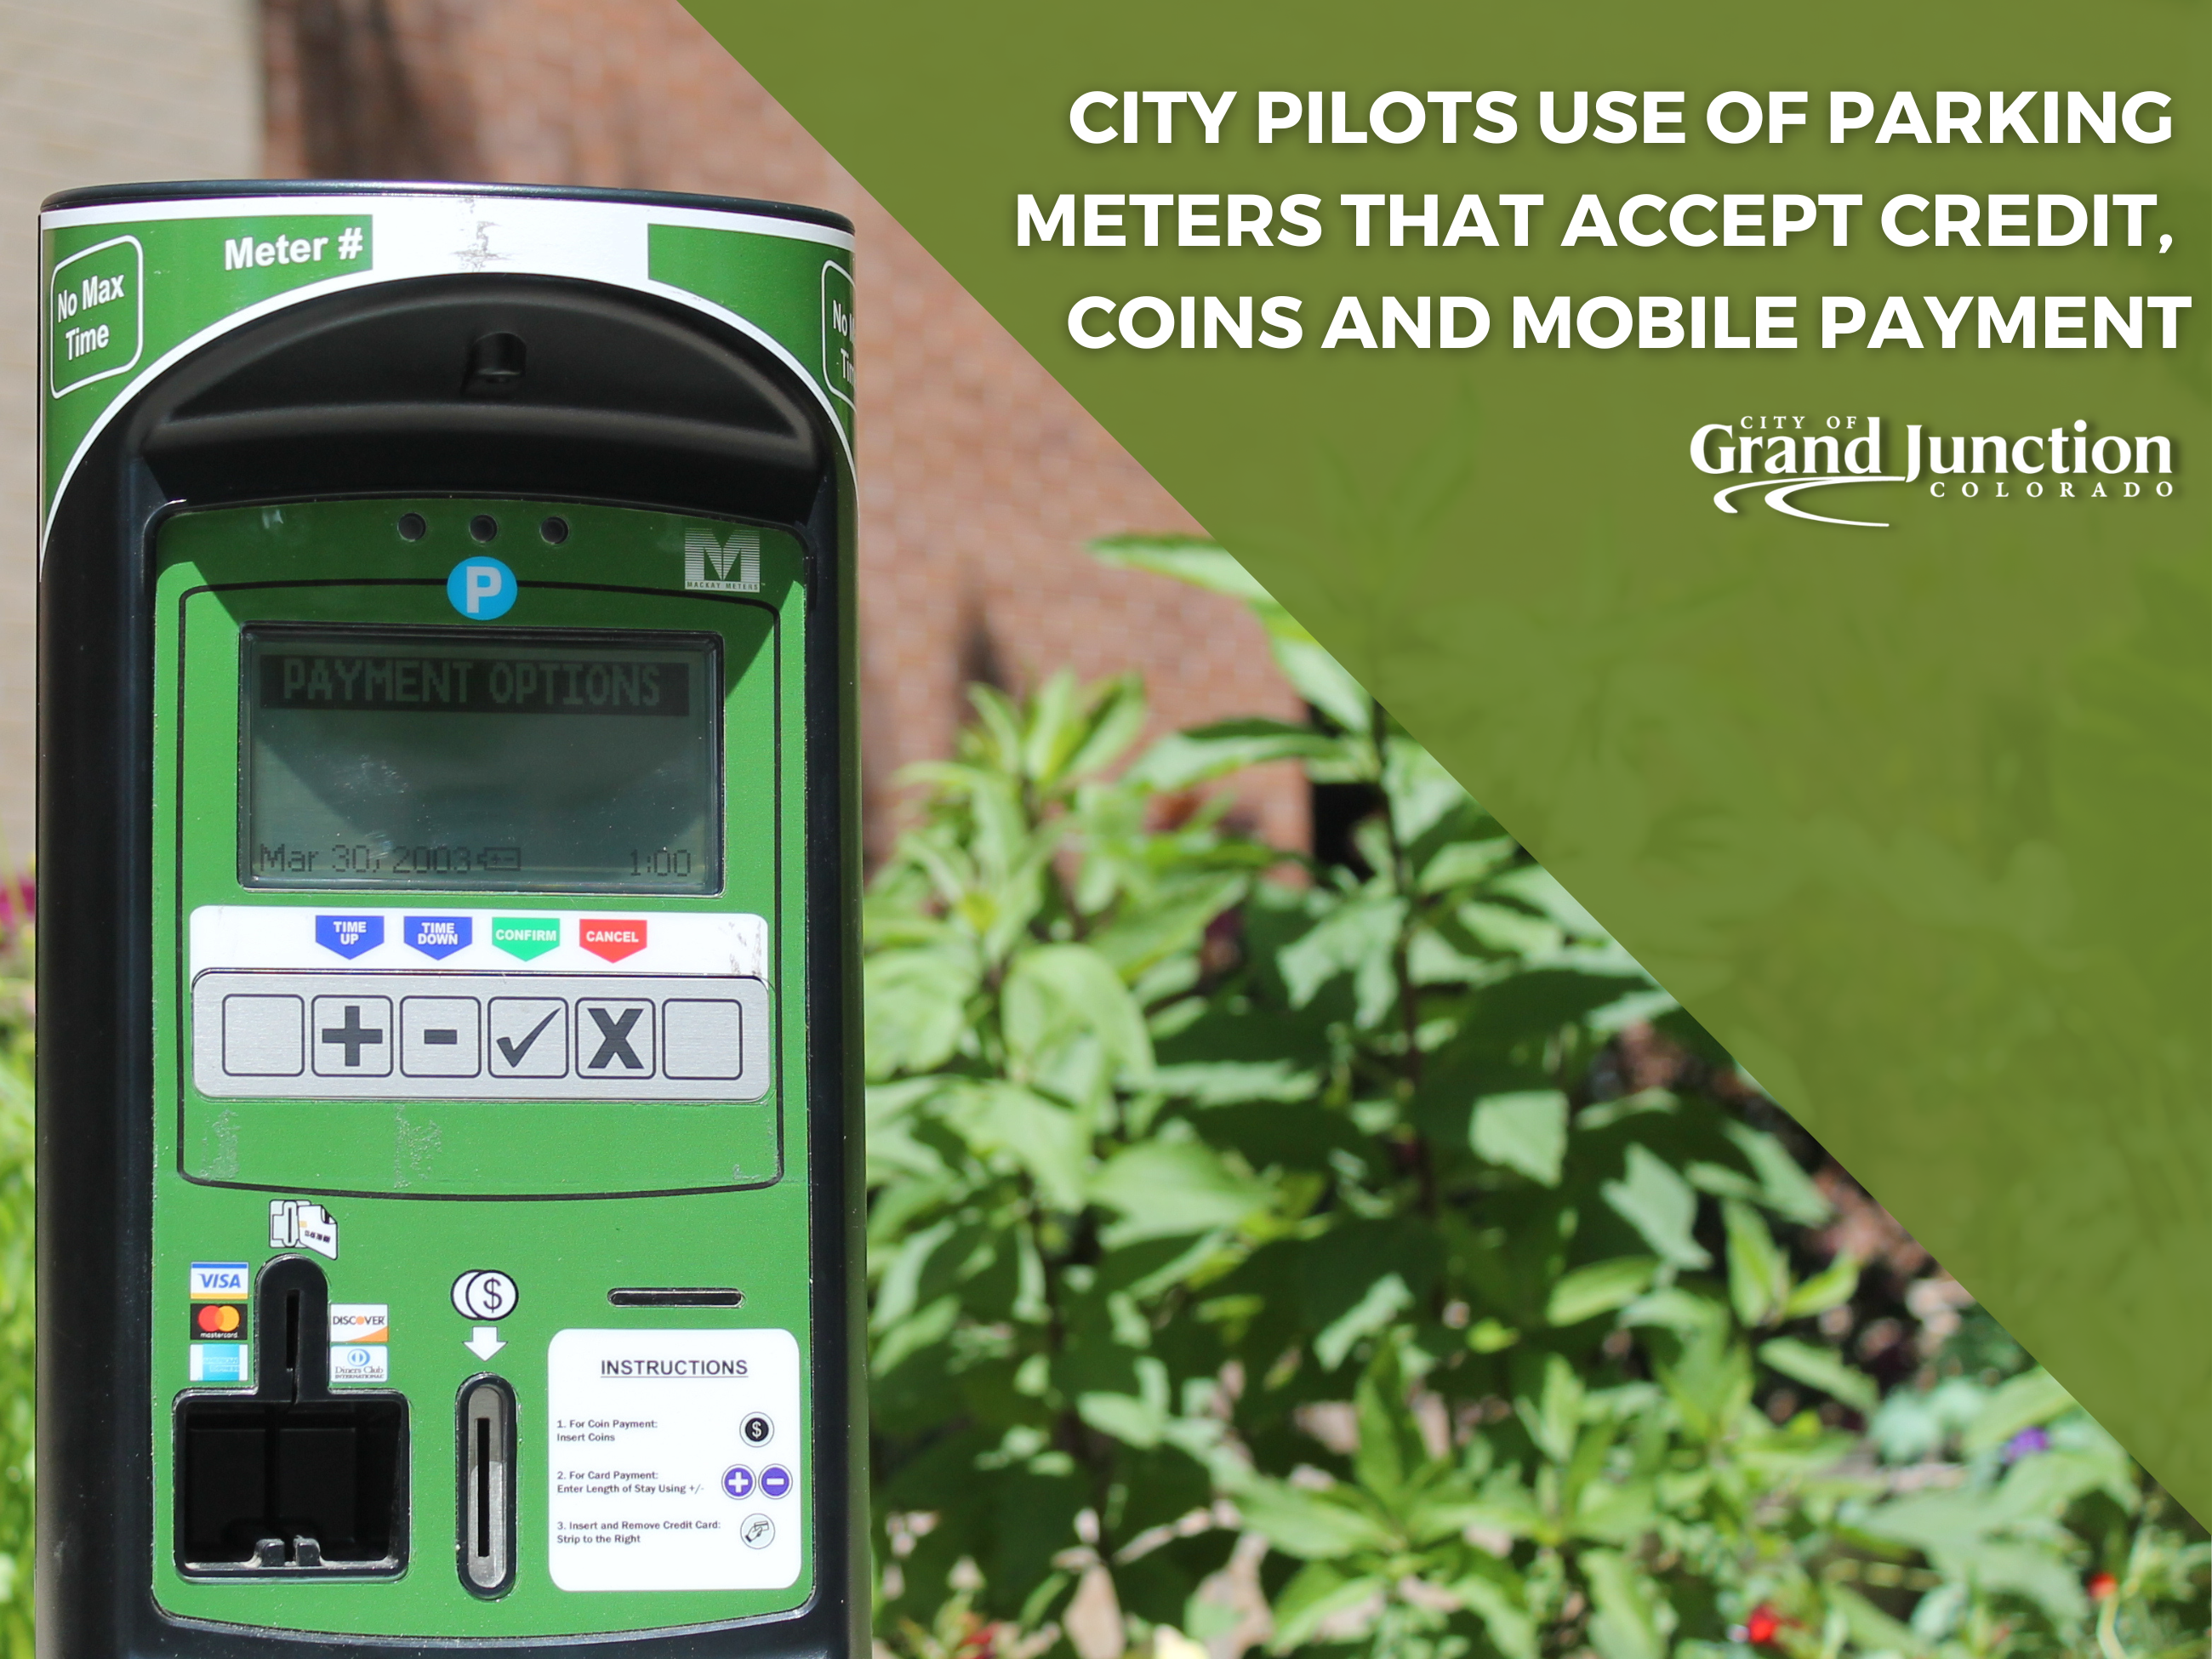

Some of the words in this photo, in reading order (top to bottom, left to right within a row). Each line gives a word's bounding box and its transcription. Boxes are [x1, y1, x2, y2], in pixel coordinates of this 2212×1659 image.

[225, 234, 328, 271] Meter
[338, 227, 363, 259] #
[57, 289, 78, 323] No
[83, 274, 125, 311] Max
[833, 299, 847, 336] No
[66, 323, 110, 361] Time
[466, 567, 502, 613] P
[283, 658, 473, 704] PAYMENT
[490, 663, 660, 708] OPTIONS
[260, 842, 319, 872] Mar
[331, 845, 381, 873] 30,
[391, 846, 471, 875] 2003
[630, 849, 693, 877] 1:00
[334, 921, 367, 933] TIME
[421, 922, 454, 934] TIME
[340, 932, 359, 945] UP
[418, 933, 458, 945] DOWN
[495, 929, 556, 942] CONFIRM
[586, 931, 639, 943] CANCEL
[198, 1273, 241, 1289] VISA
[333, 1314, 385, 1326] DISCOVER
[335, 1365, 362, 1374] Diners
[601, 1360, 748, 1376] INSTRUCTIONS
[556, 1419, 567, 1428] 1.
[569, 1419, 585, 1428] For
[587, 1419, 610, 1428] Coin
[613, 1419, 658, 1430] Payment:
[556, 1434, 585, 1442] Insert
[588, 1433, 615, 1442] Coins
[556, 1471, 567, 1479] 2.
[569, 1471, 584, 1479] For
[587, 1471, 610, 1479] Card
[613, 1471, 658, 1481] Payment:
[556, 1485, 583, 1494] Enter
[586, 1484, 619, 1495] Length
[622, 1484, 632, 1493] of
[634, 1485, 656, 1495] Stay
[658, 1485, 687, 1495] Using
[556, 1521, 567, 1530] 3.
[569, 1521, 597, 1530] Insert
[601, 1521, 619, 1530] and
[621, 1521, 660, 1530] Remove
[663, 1520, 693, 1530] Credit
[695, 1520, 721, 1530] Card:
[556, 1535, 580, 1545] Strip
[583, 1535, 593, 1543] to
[596, 1535, 612, 1543] the
[614, 1535, 641, 1545] Right
